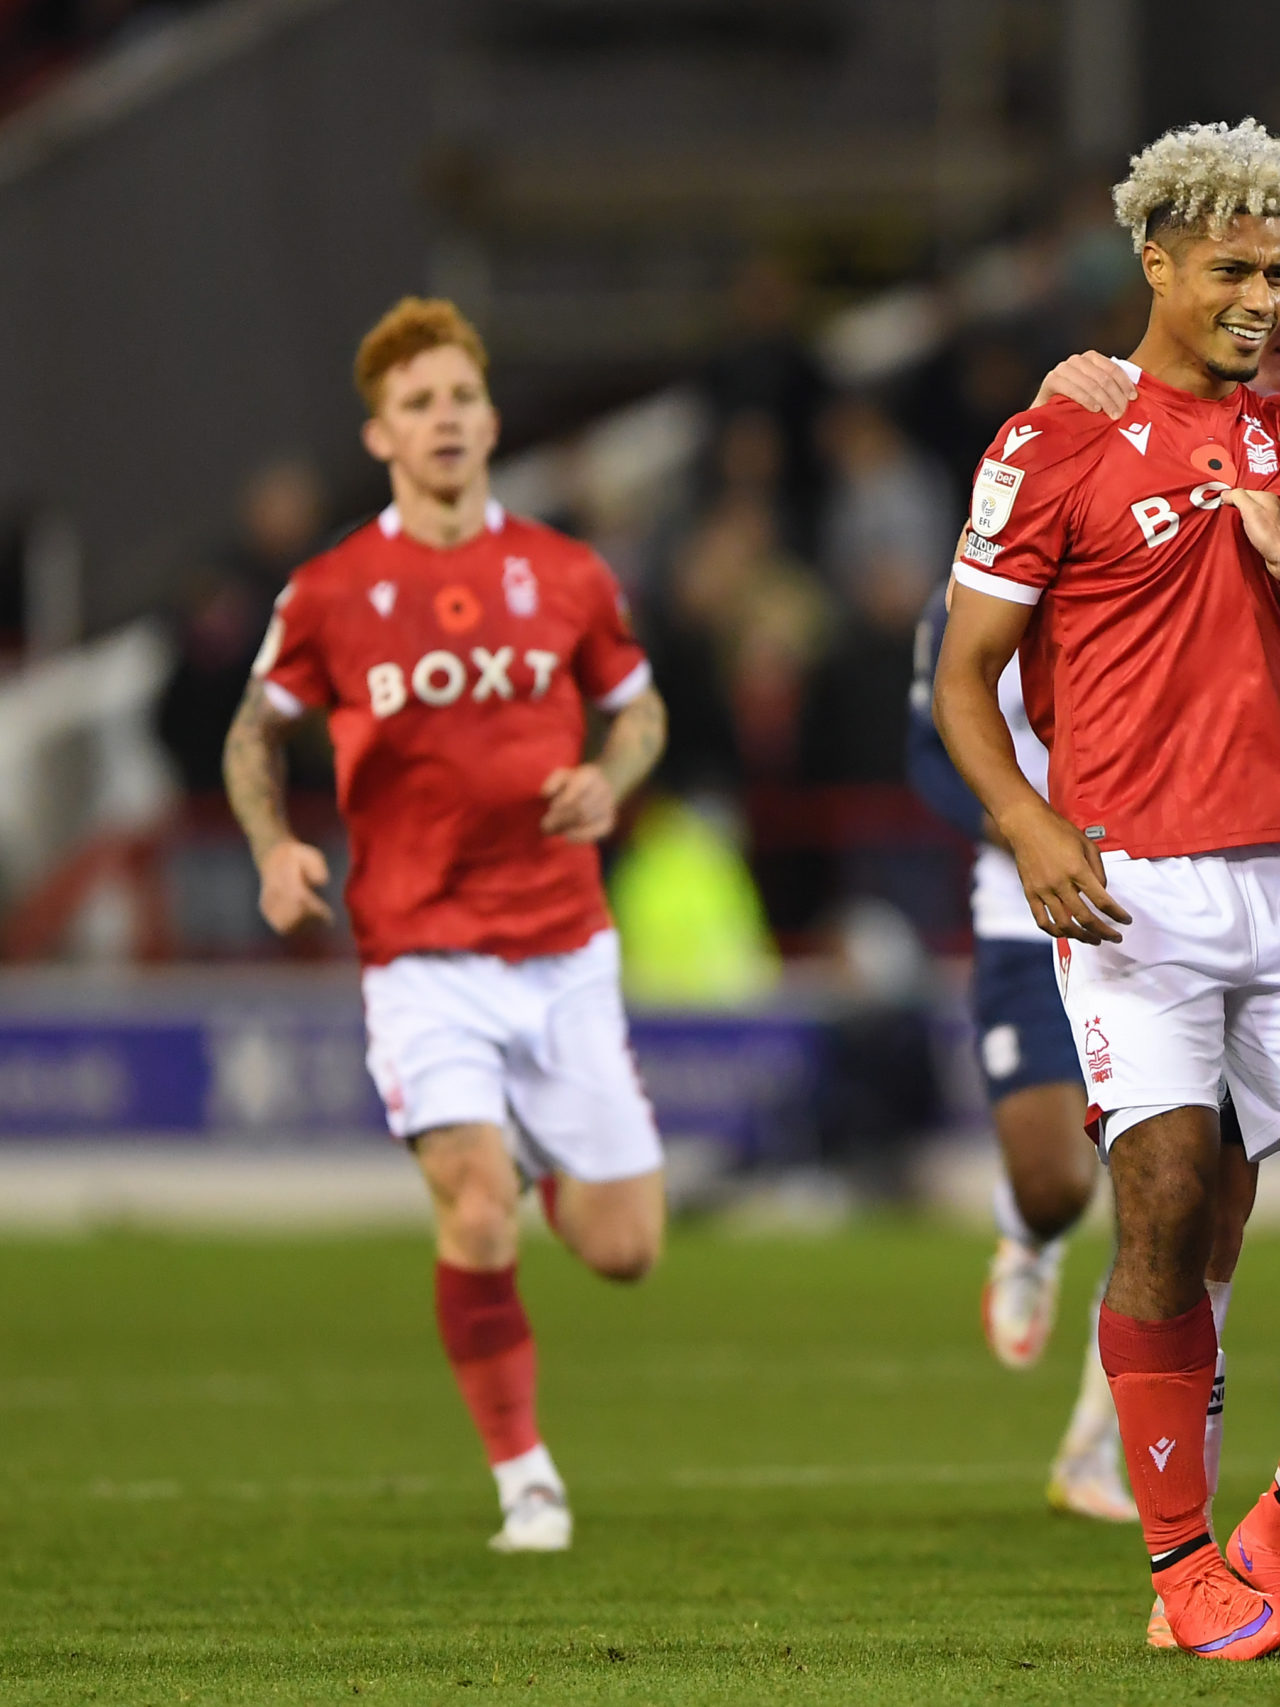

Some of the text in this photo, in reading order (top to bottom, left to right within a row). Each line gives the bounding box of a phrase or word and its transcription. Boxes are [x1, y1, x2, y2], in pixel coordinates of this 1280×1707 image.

[983, 467, 1015, 487] sky bet
[978, 516, 991, 529] EFL
[1130, 481, 1232, 549] BO
[366, 646, 559, 719] BOXT
